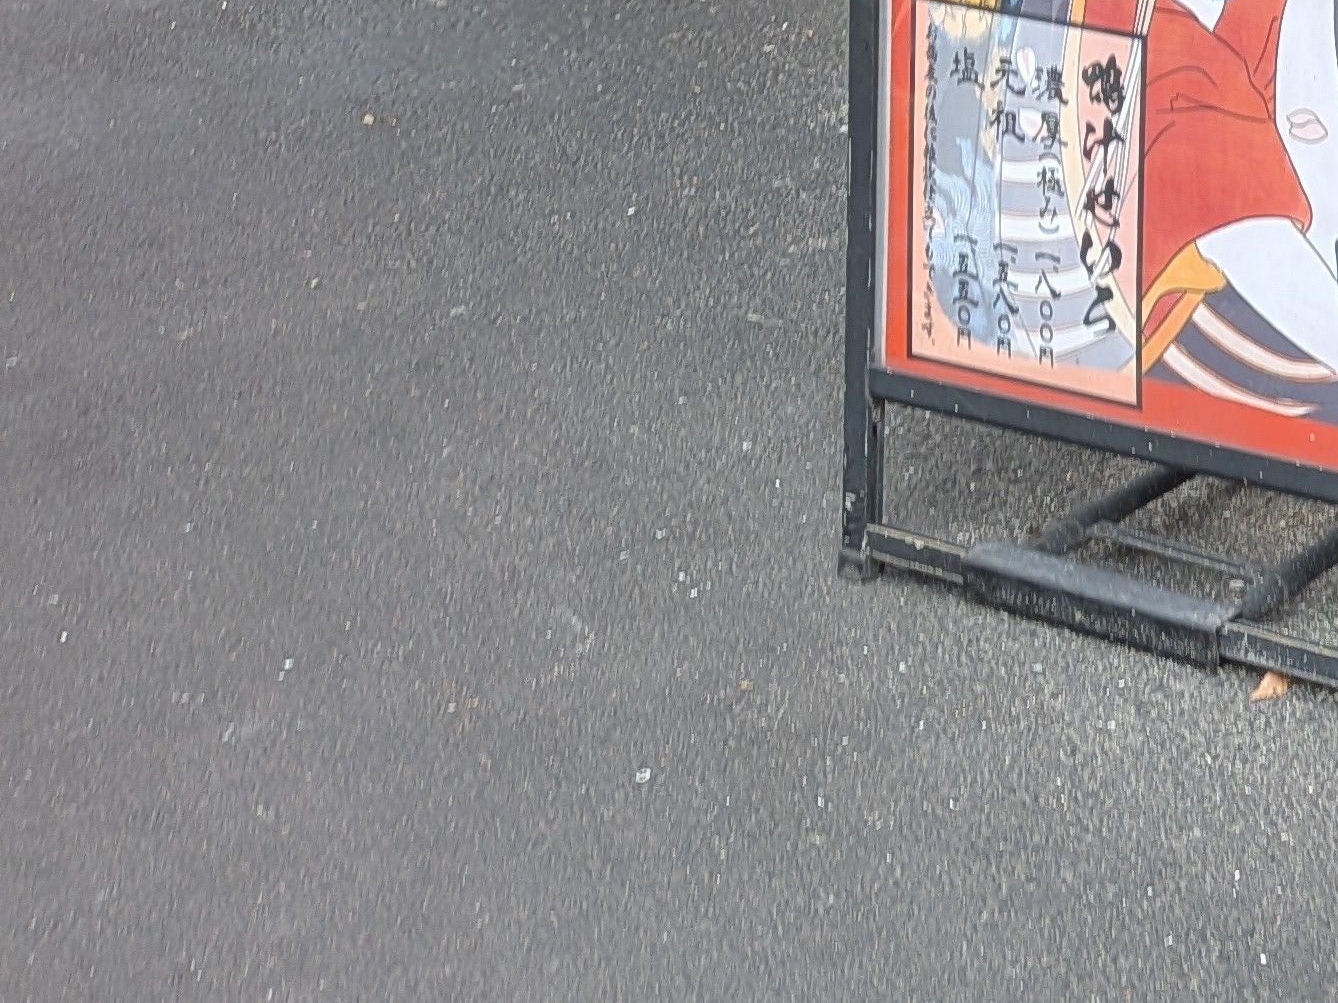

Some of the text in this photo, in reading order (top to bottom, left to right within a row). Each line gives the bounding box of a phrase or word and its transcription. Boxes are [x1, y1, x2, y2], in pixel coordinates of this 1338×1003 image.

[950, 46, 986, 92] 塩
[984, 55, 1026, 143] 元祖
[1081, 53, 1127, 333] 鴨汁せいろ
